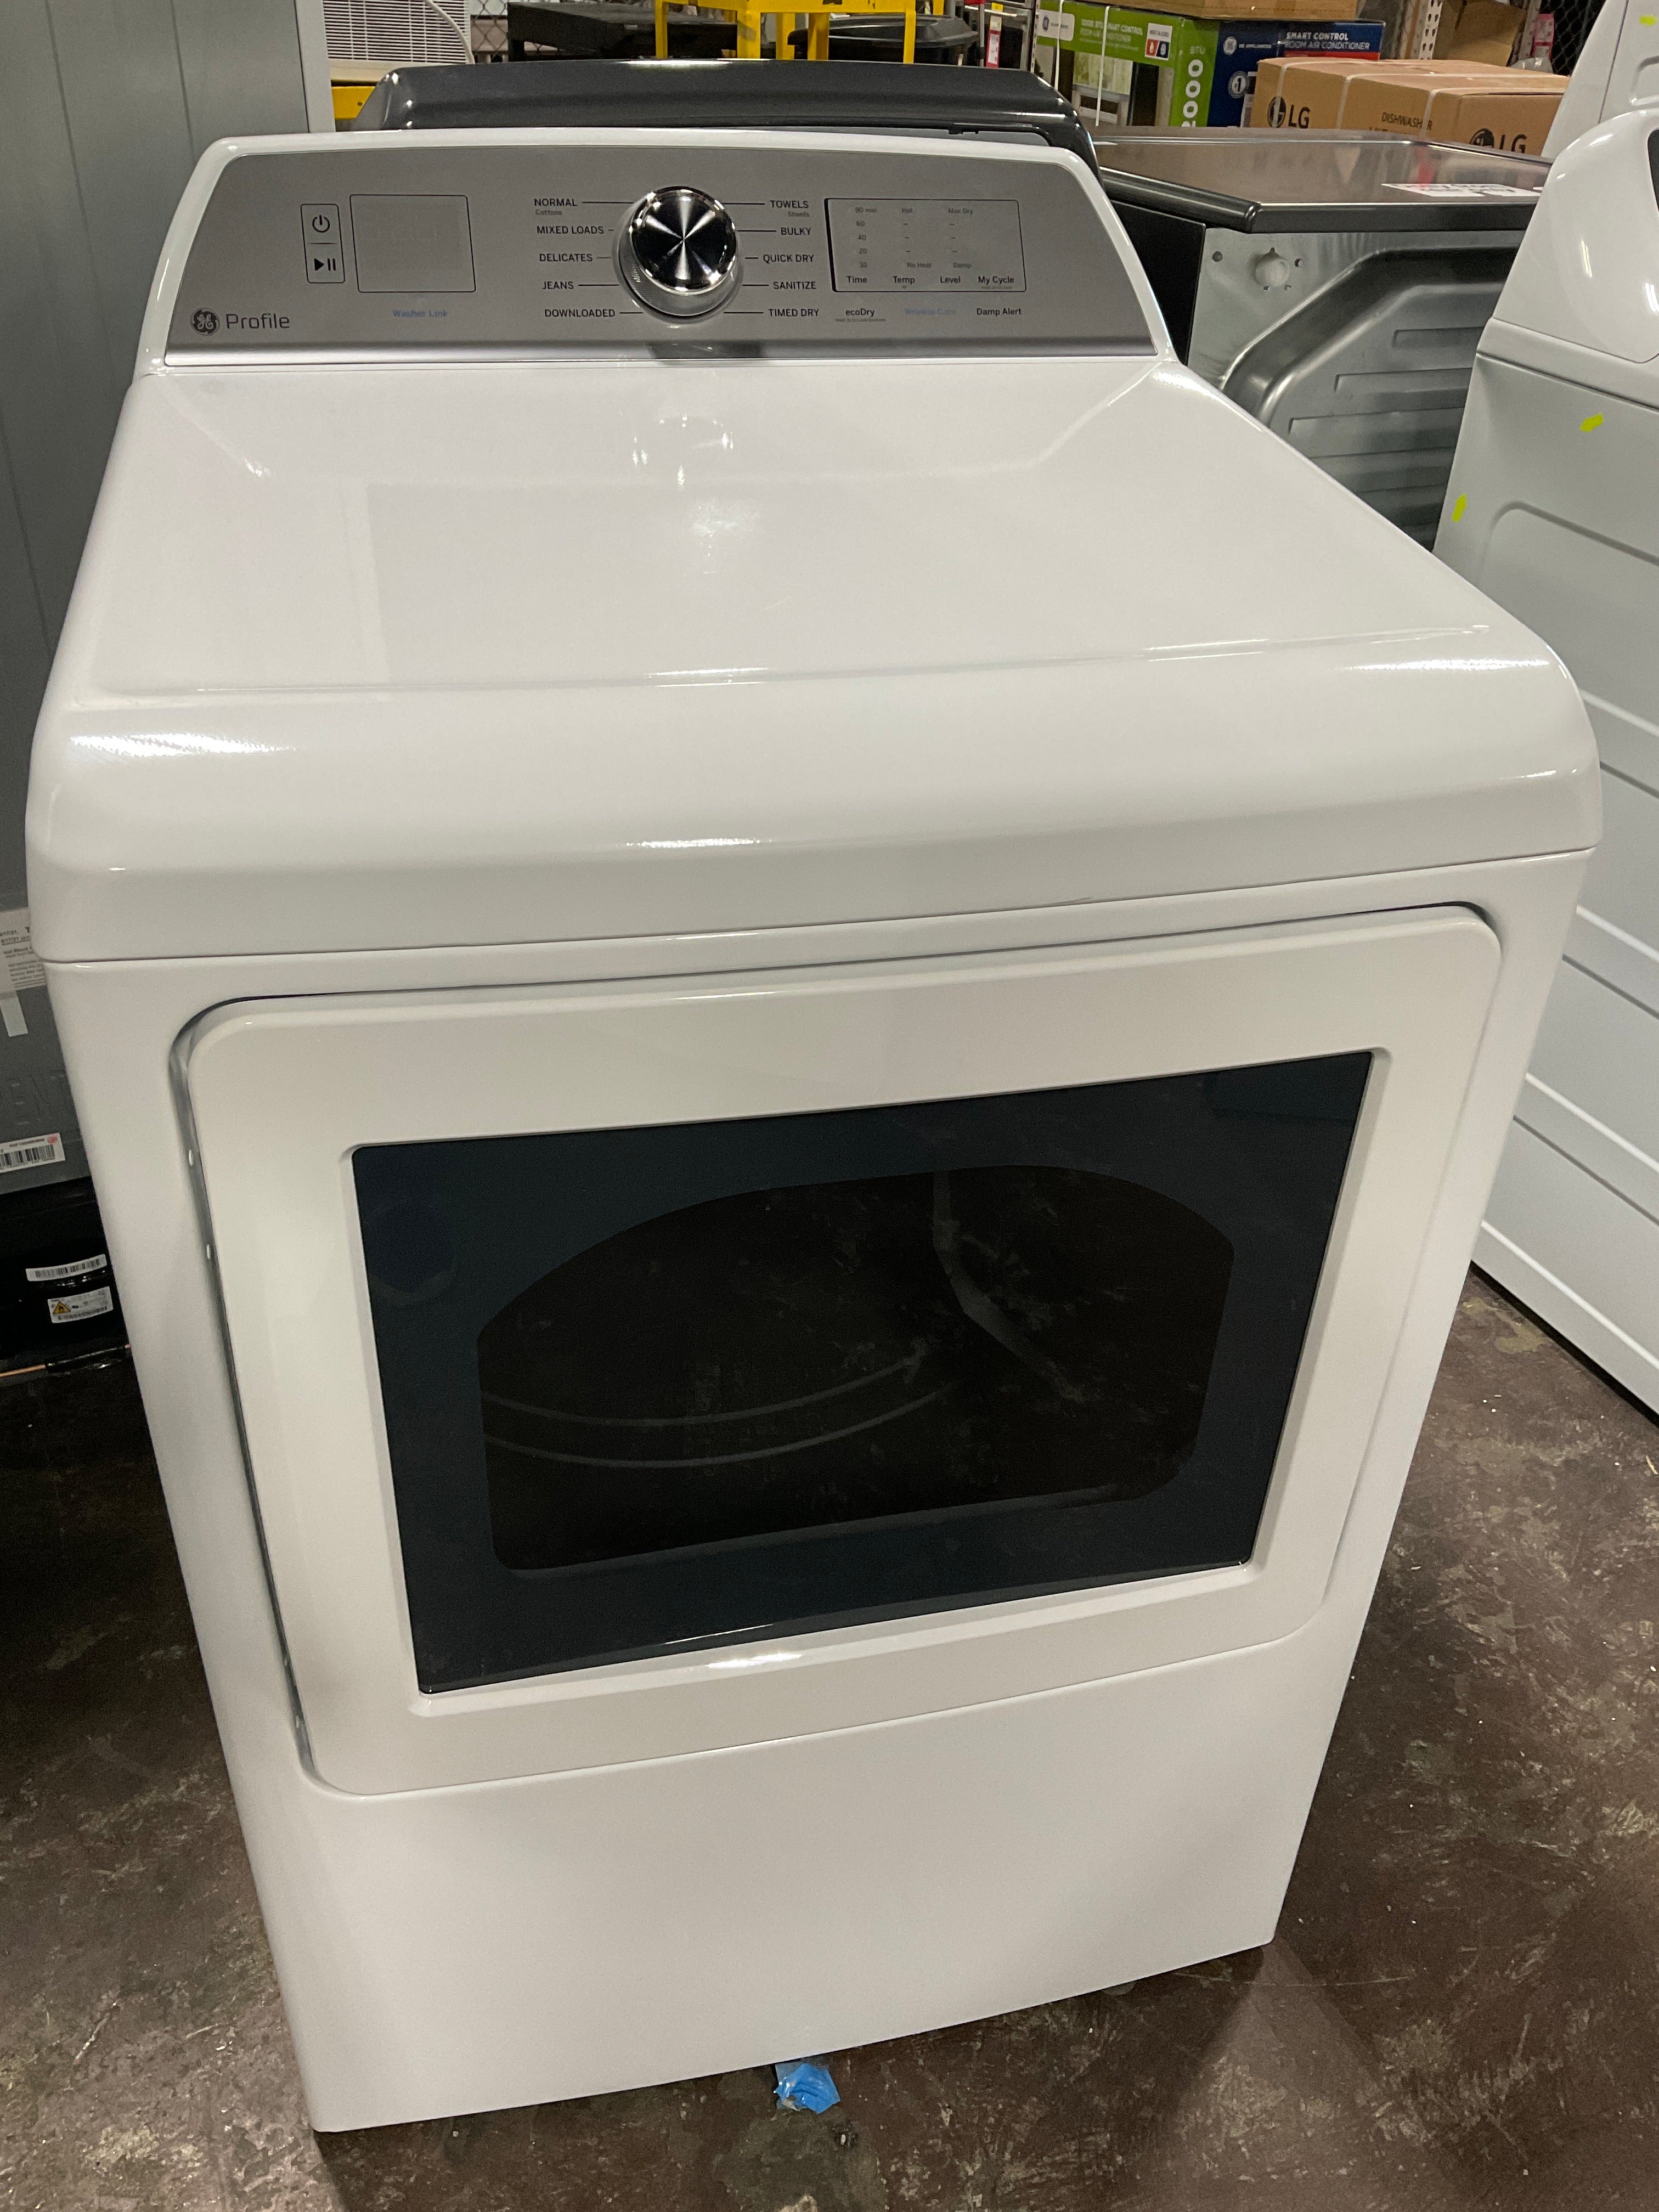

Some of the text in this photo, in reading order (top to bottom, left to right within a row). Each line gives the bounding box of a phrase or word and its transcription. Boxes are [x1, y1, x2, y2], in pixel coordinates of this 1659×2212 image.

[1286, 32, 1349, 41] SMART CONTROL
[1189, 46, 1206, 54] BTU
[1321, 42, 1370, 50] CONDITIONER
[1288, 104, 1311, 129] LG
[1381, 112, 1433, 131] DISHWASHR
[534, 198, 578, 207] NORMAL
[770, 200, 809, 208] TOWELS
[962, 207, 974, 216] Dry
[537, 225, 604, 234] MIXED LOADS
[781, 227, 811, 235] BULKY
[539, 253, 593, 262] DELICATES
[763, 253, 815, 263] QUICK DRY
[846, 275, 868, 284] Time
[893, 276, 916, 285] Temp
[940, 276, 961, 284] Level
[978, 276, 1015, 285] My Cycle
[541, 280, 574, 290] JEANS
[773, 281, 817, 290] SANITIZE
[392, 308, 448, 318] Washer Link
[544, 308, 616, 318] DOWNLOADED
[768, 308, 819, 318] TIMED DRY
[845, 308, 876, 318] ecoDry
[977, 308, 1023, 317] Damp Alert
[225, 313, 290, 330] Profile
